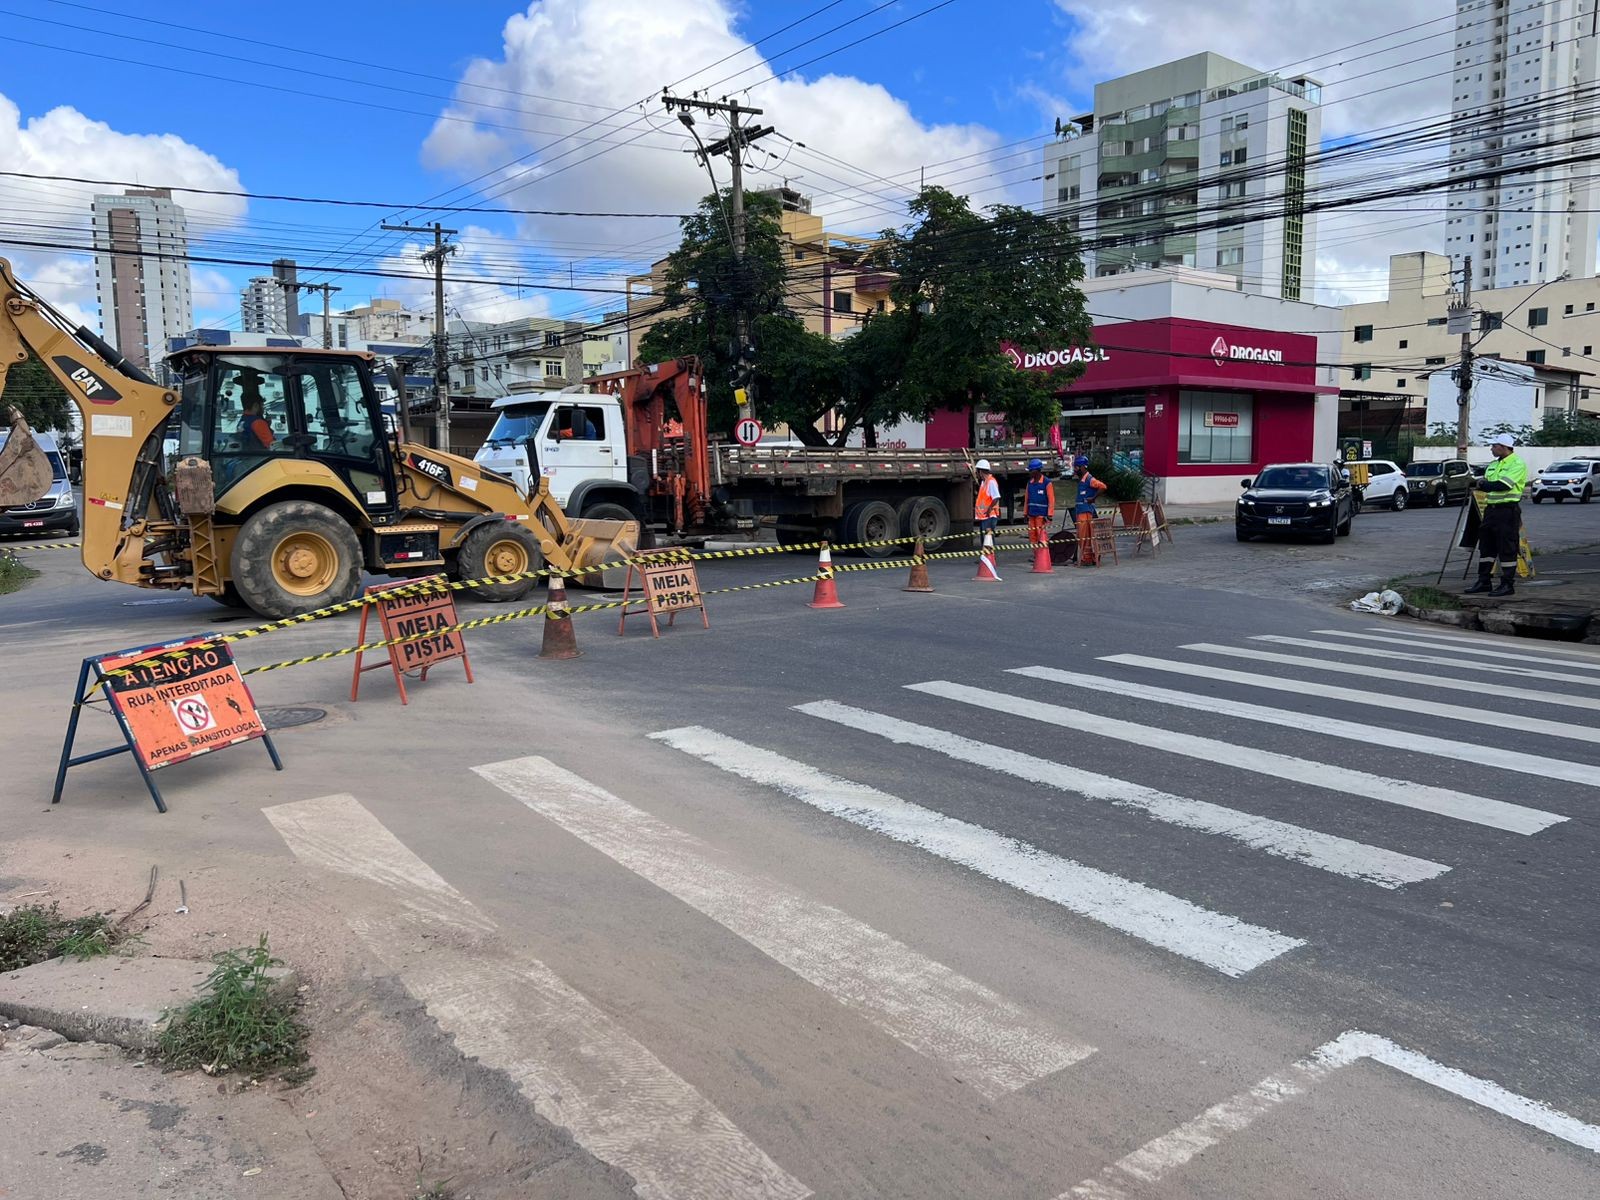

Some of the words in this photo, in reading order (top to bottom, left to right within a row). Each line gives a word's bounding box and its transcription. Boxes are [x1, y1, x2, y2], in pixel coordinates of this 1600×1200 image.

[1024, 347, 1110, 368] DROGASIL
[1230, 345, 1285, 366] DROGASIL
[70, 367, 103, 396] CAT
[652, 574, 690, 590] MEIA
[656, 590, 694, 607] PISTA
[397, 612, 449, 637] MEIA
[403, 634, 455, 661] PISTA
[127, 692, 156, 708] RUA
[156, 673, 235, 701] INTERDITADA
[150, 740, 188, 760] APENAS
[232, 720, 259, 734] LOCAL
